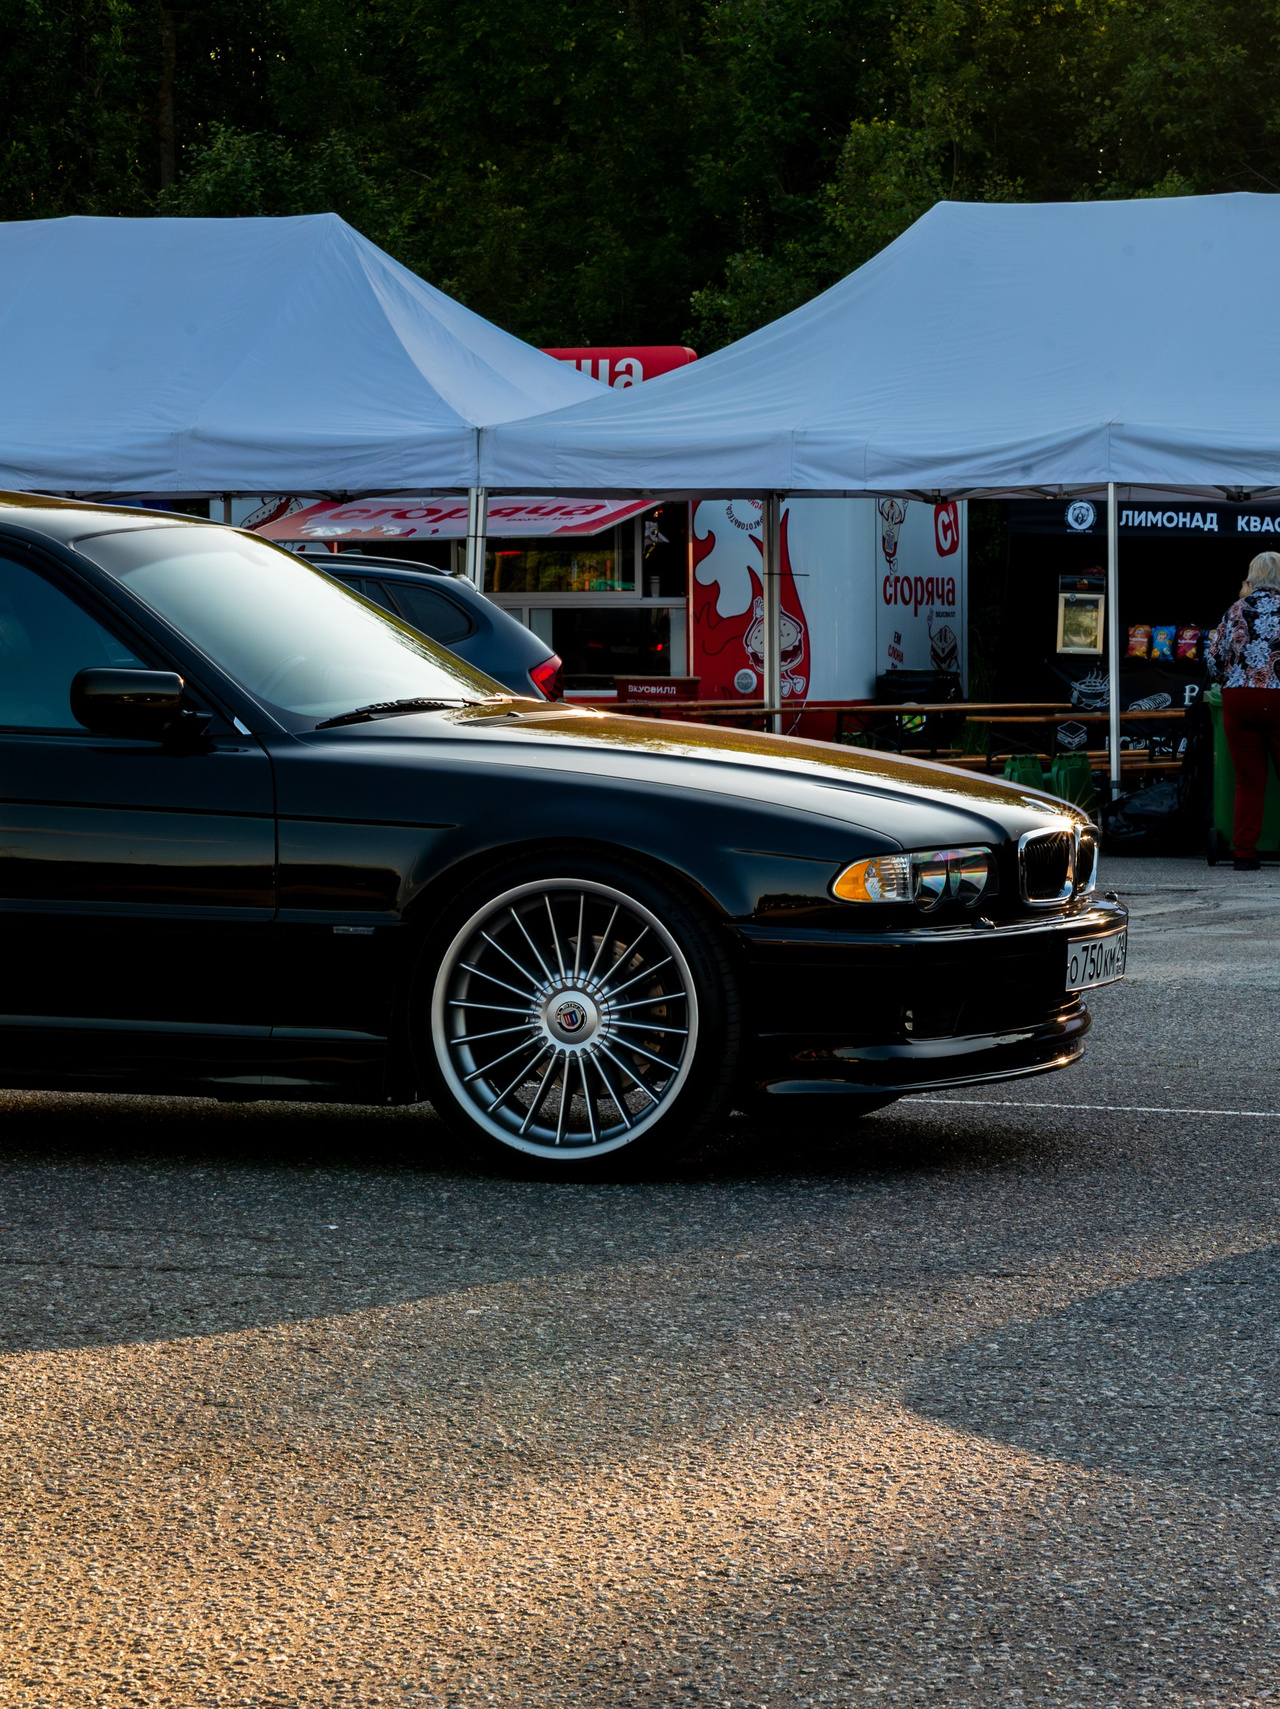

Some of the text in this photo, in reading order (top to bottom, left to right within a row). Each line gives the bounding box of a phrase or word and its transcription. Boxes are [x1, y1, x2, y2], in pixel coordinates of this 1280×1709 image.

[328, 503, 607, 524] сгоряча
[725, 503, 764, 531] РИГОТОВЬТЕСЬ,
[1119, 510, 1219, 533] ЛИМОНАД
[883, 575, 956, 618] сгоряча
[627, 684, 677, 695] ВКУСВИЛЛ
